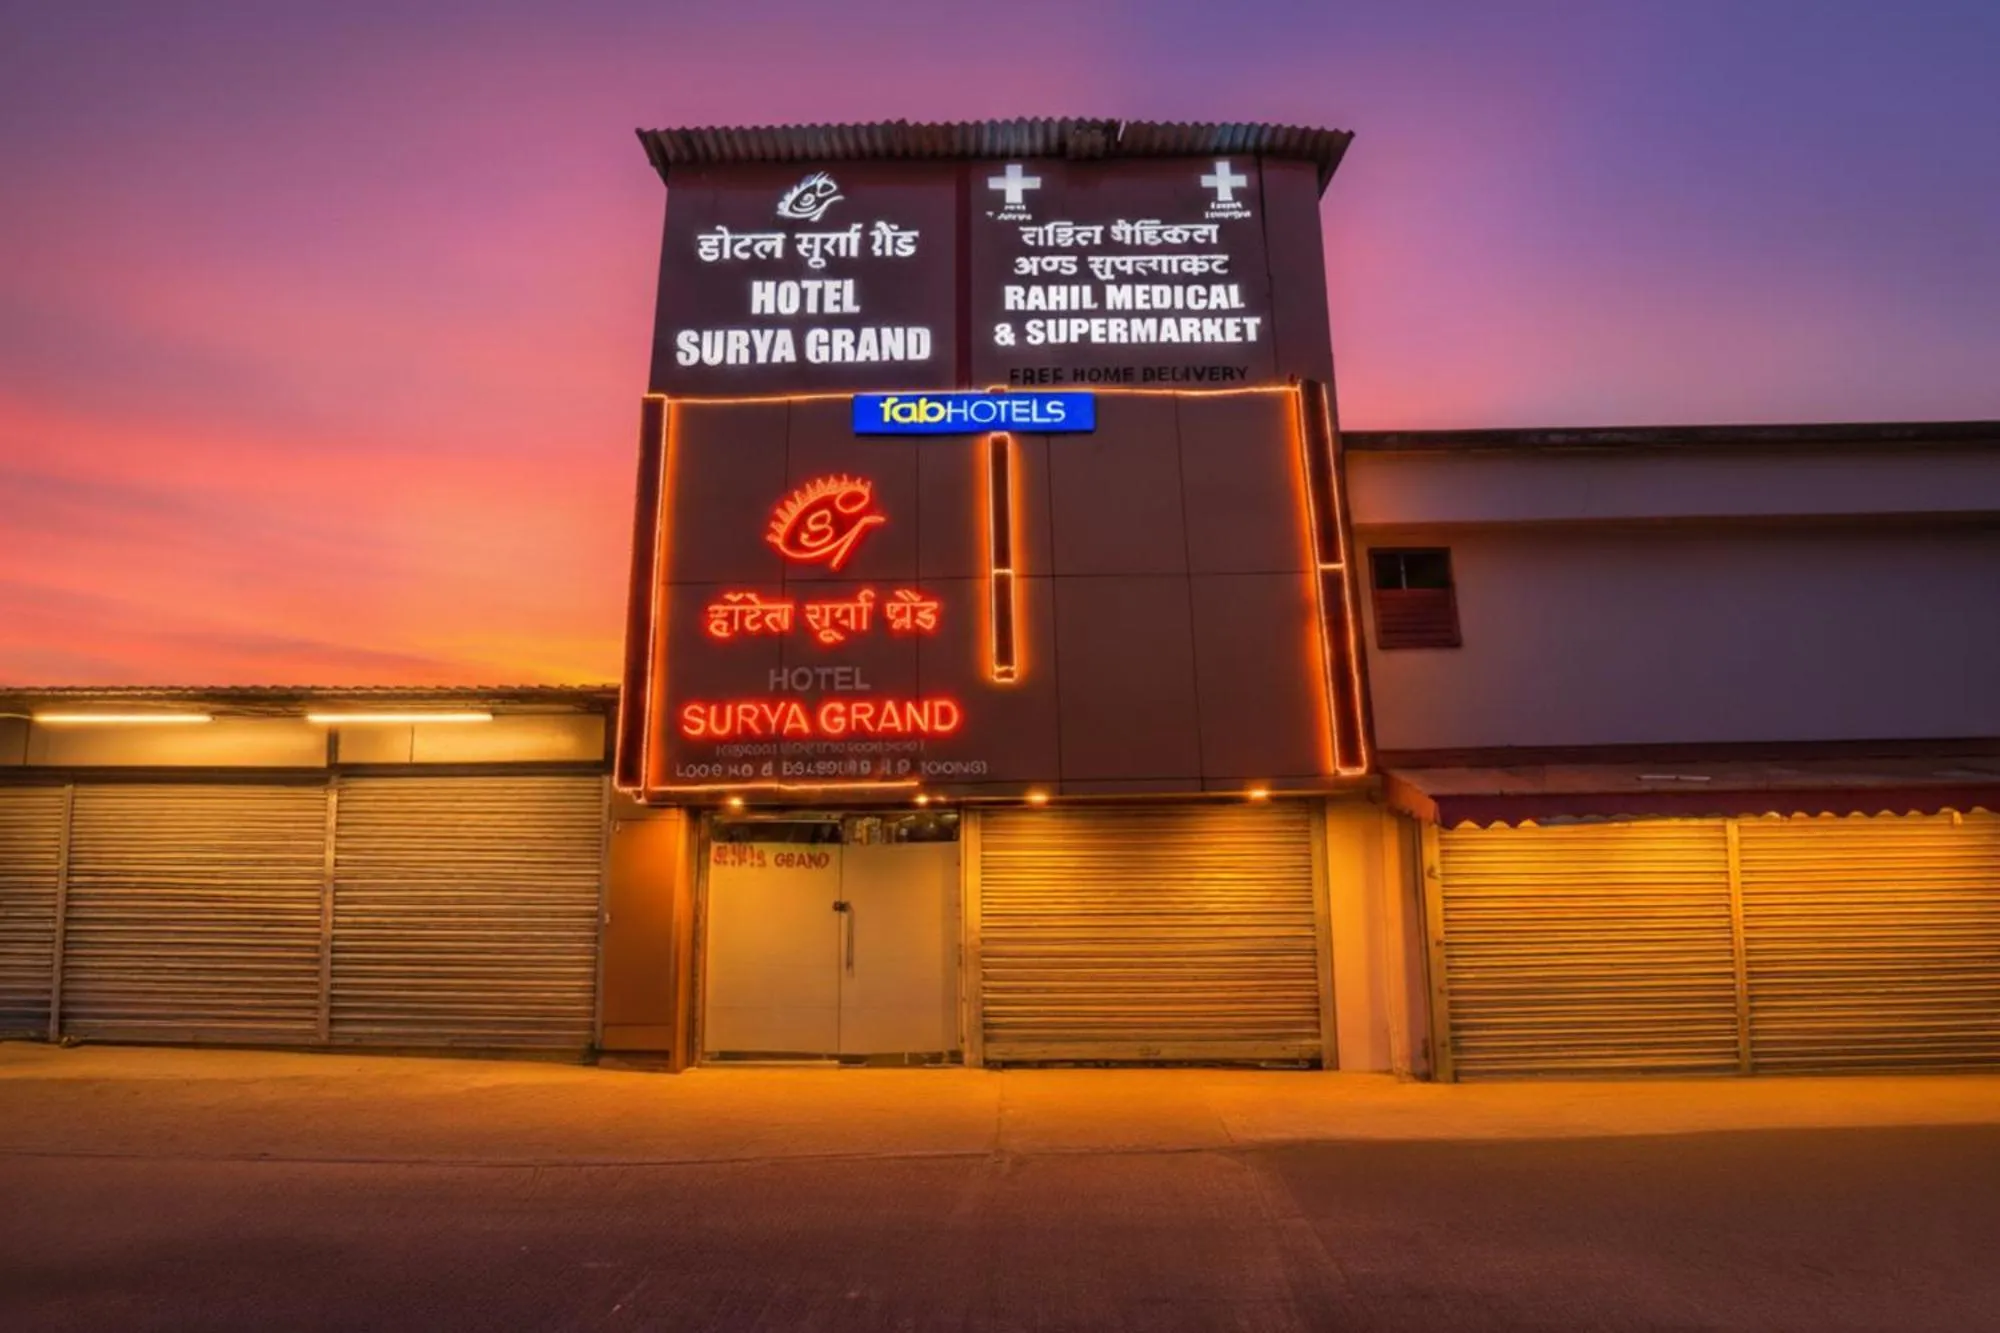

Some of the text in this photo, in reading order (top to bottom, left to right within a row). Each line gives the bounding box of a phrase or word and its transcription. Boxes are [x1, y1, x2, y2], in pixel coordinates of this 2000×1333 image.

[697, 225, 786, 262] होटल
[751, 279, 861, 314] HOTEL
[1004, 284, 1245, 311] RAHIL MEDICAL
[675, 327, 931, 367] SURYA GRAND
[994, 317, 1261, 346] & SUPERMARKET
[1072, 366, 1135, 383] HOME
[1142, 365, 1249, 382] DELIVERY
[768, 666, 871, 691] HOTEL
[682, 700, 960, 736] SURYA GRAND
